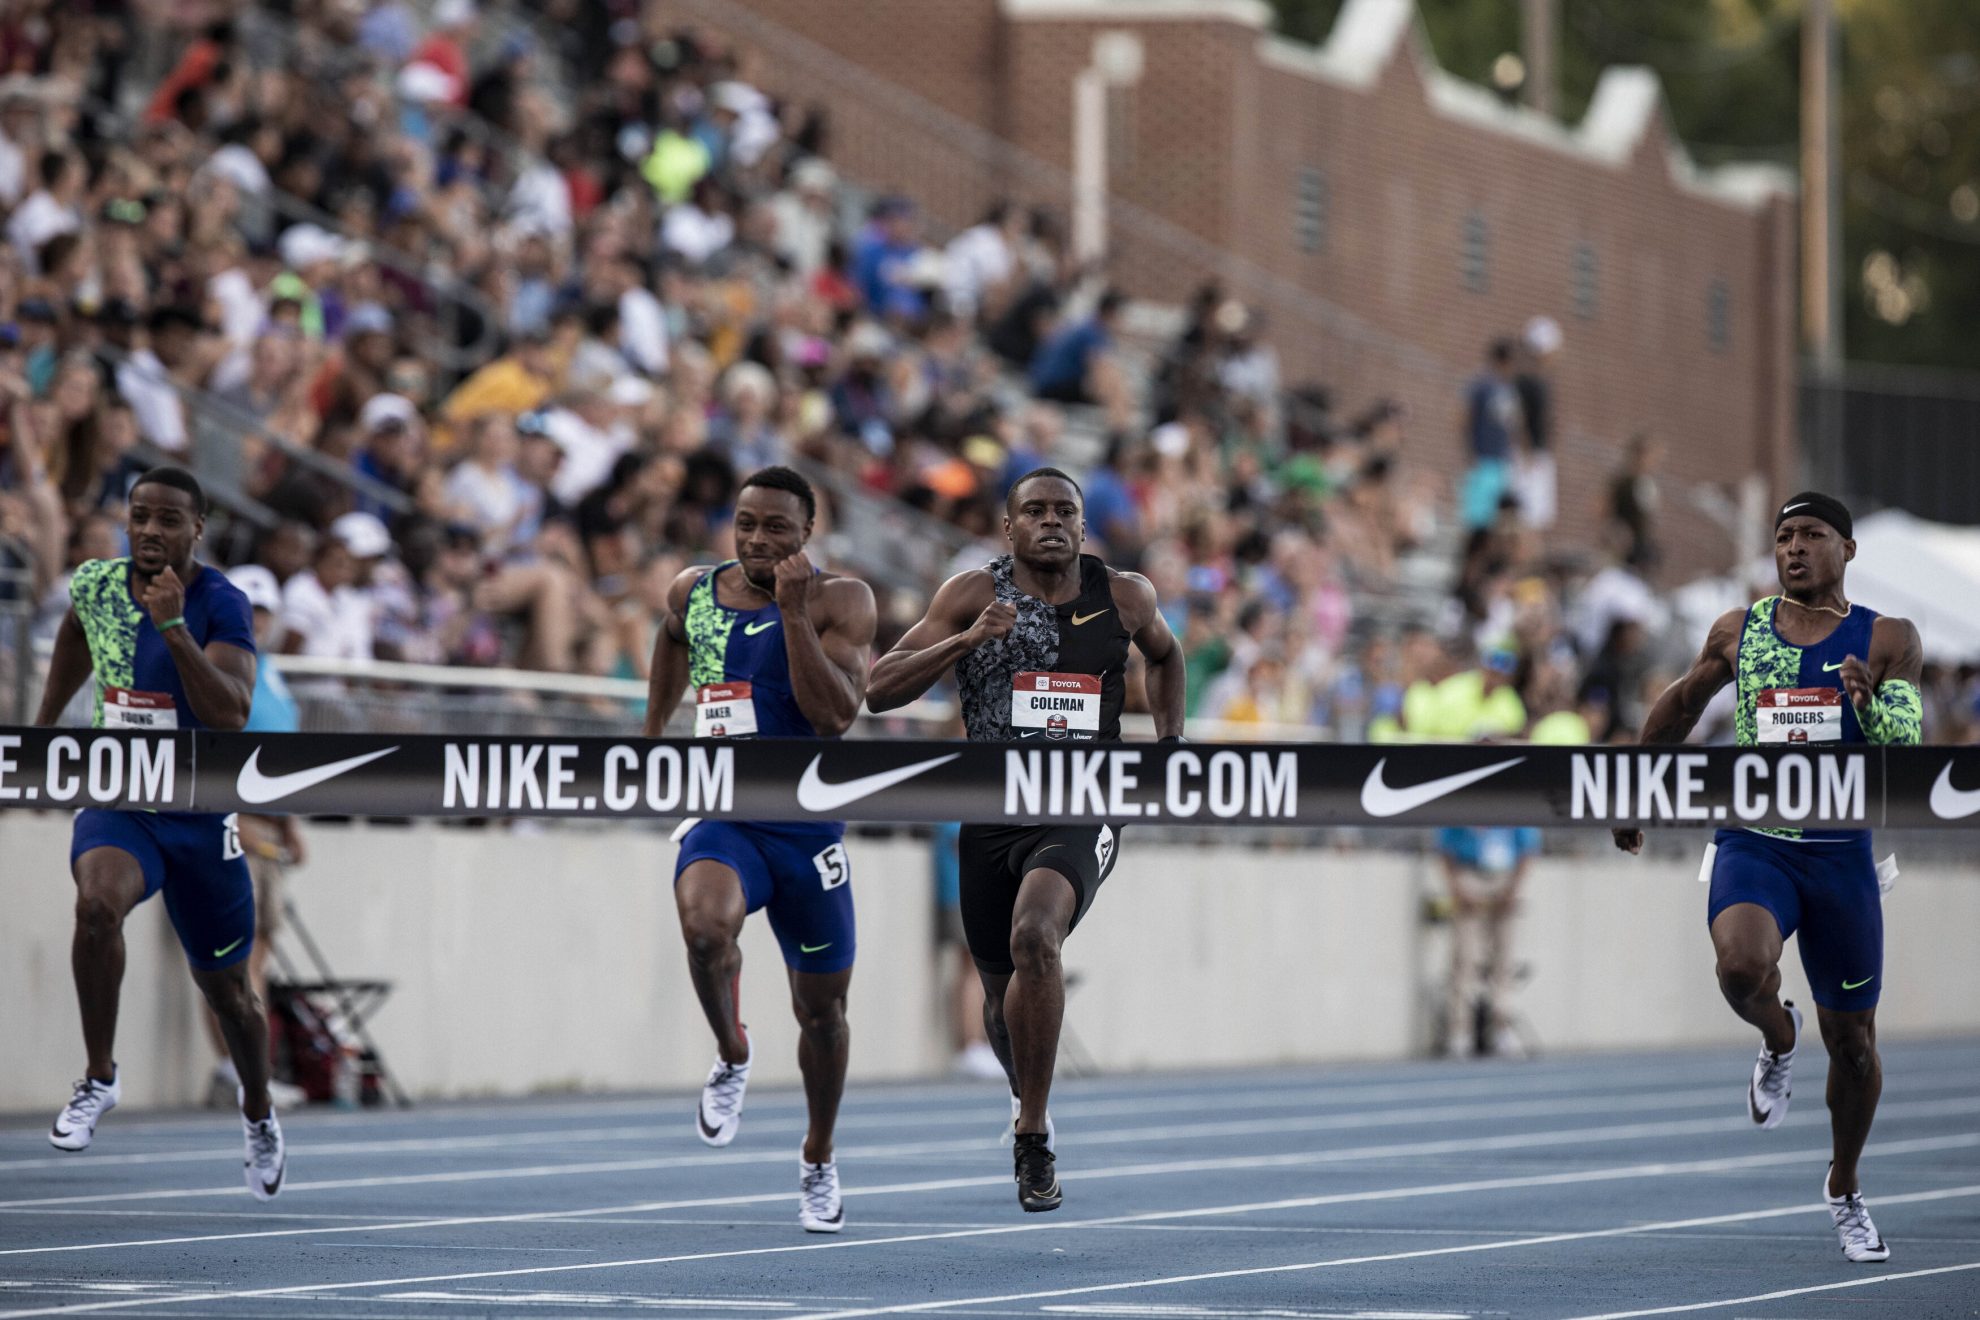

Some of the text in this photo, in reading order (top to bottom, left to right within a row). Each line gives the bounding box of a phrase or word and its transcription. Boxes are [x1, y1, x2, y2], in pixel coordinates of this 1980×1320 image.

[1051, 680, 1082, 689] TOYOTA
[1030, 696, 1085, 712] COLEMAN
[1789, 695, 1820, 703] TOYOTA
[120, 710, 155, 725] YOUNG
[1771, 711, 1825, 725] RODGERS
[442, 744, 734, 812] NIKE.COM
[1004, 750, 1298, 818] NIKE.COM
[1571, 755, 1866, 821] NIKE.COM
[822, 847, 843, 885] 5
